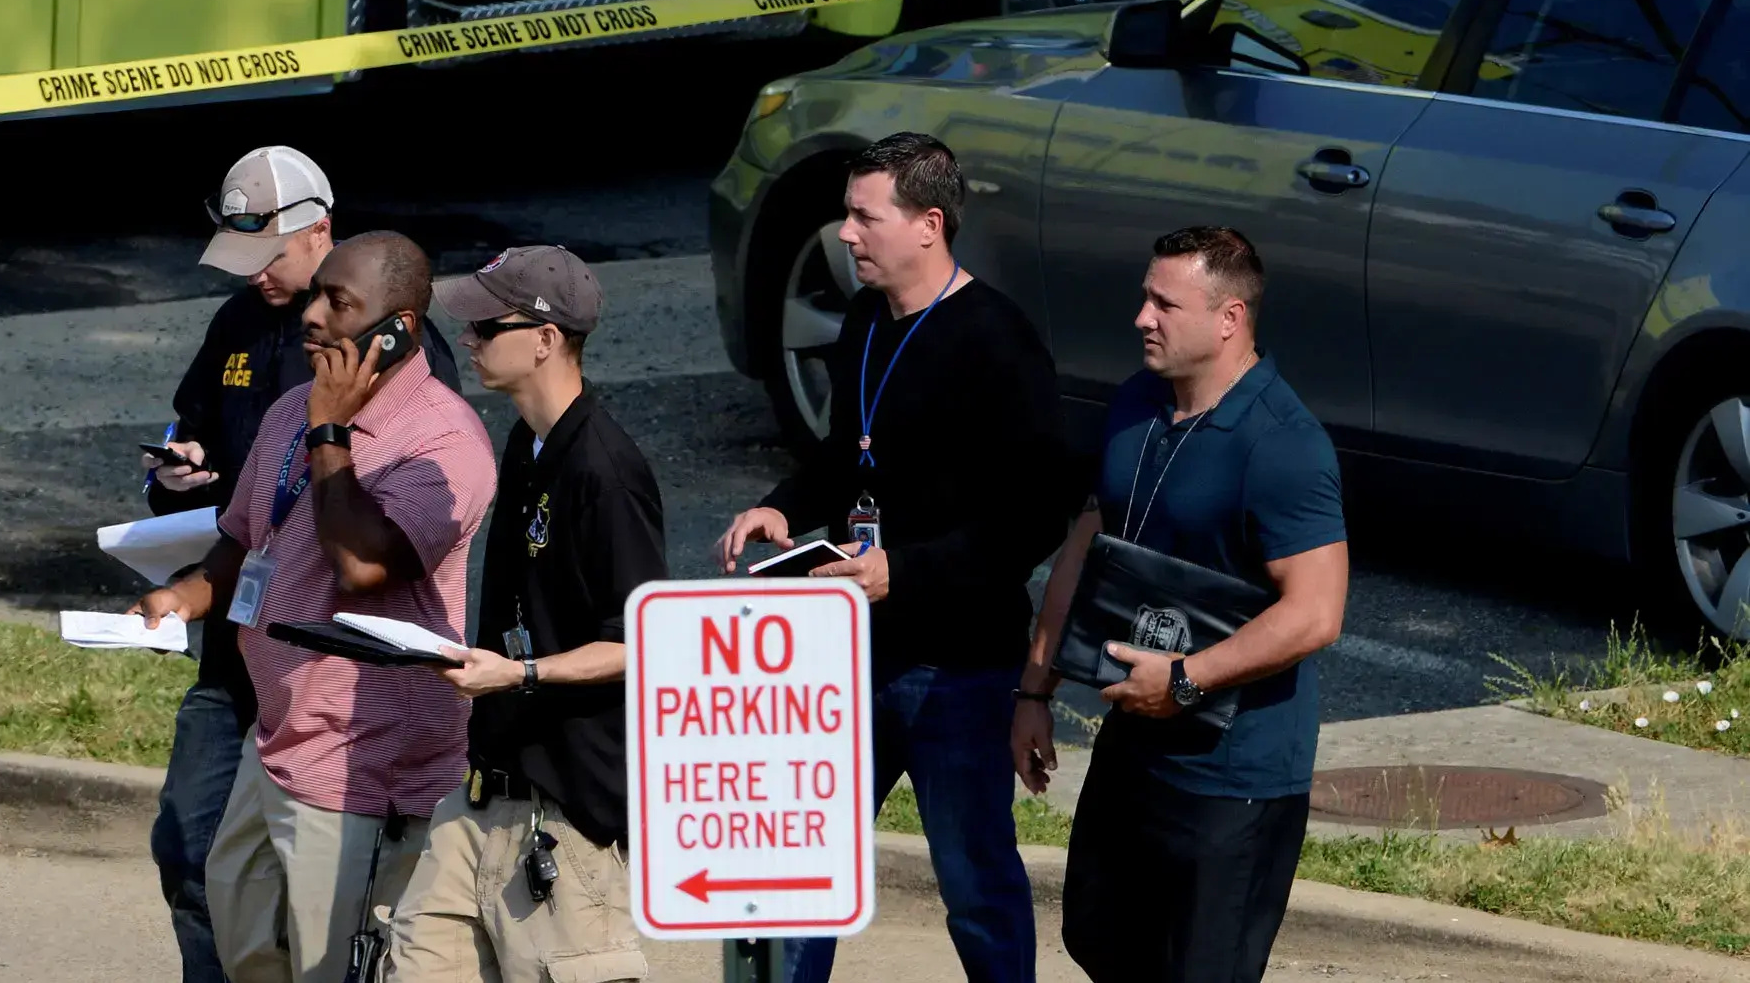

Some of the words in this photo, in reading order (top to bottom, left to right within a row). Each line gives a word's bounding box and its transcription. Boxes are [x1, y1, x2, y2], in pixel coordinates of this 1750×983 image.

[396, 28, 460, 58] CRIME
[460, 20, 523, 50] SCENE
[523, 17, 551, 42] DO
[555, 13, 592, 38] NOT
[593, 5, 658, 33] CROSS
[38, 72, 101, 103] CRIME
[103, 65, 163, 95] SCENE
[166, 62, 193, 88] DO
[195, 57, 233, 84] NOT
[237, 49, 300, 79] CROSS
[701, 614, 794, 675] NO
[655, 683, 842, 737] PARKING
[663, 761, 768, 804] HERE
[788, 760, 837, 800] TO
[677, 810, 827, 851] CORNER
